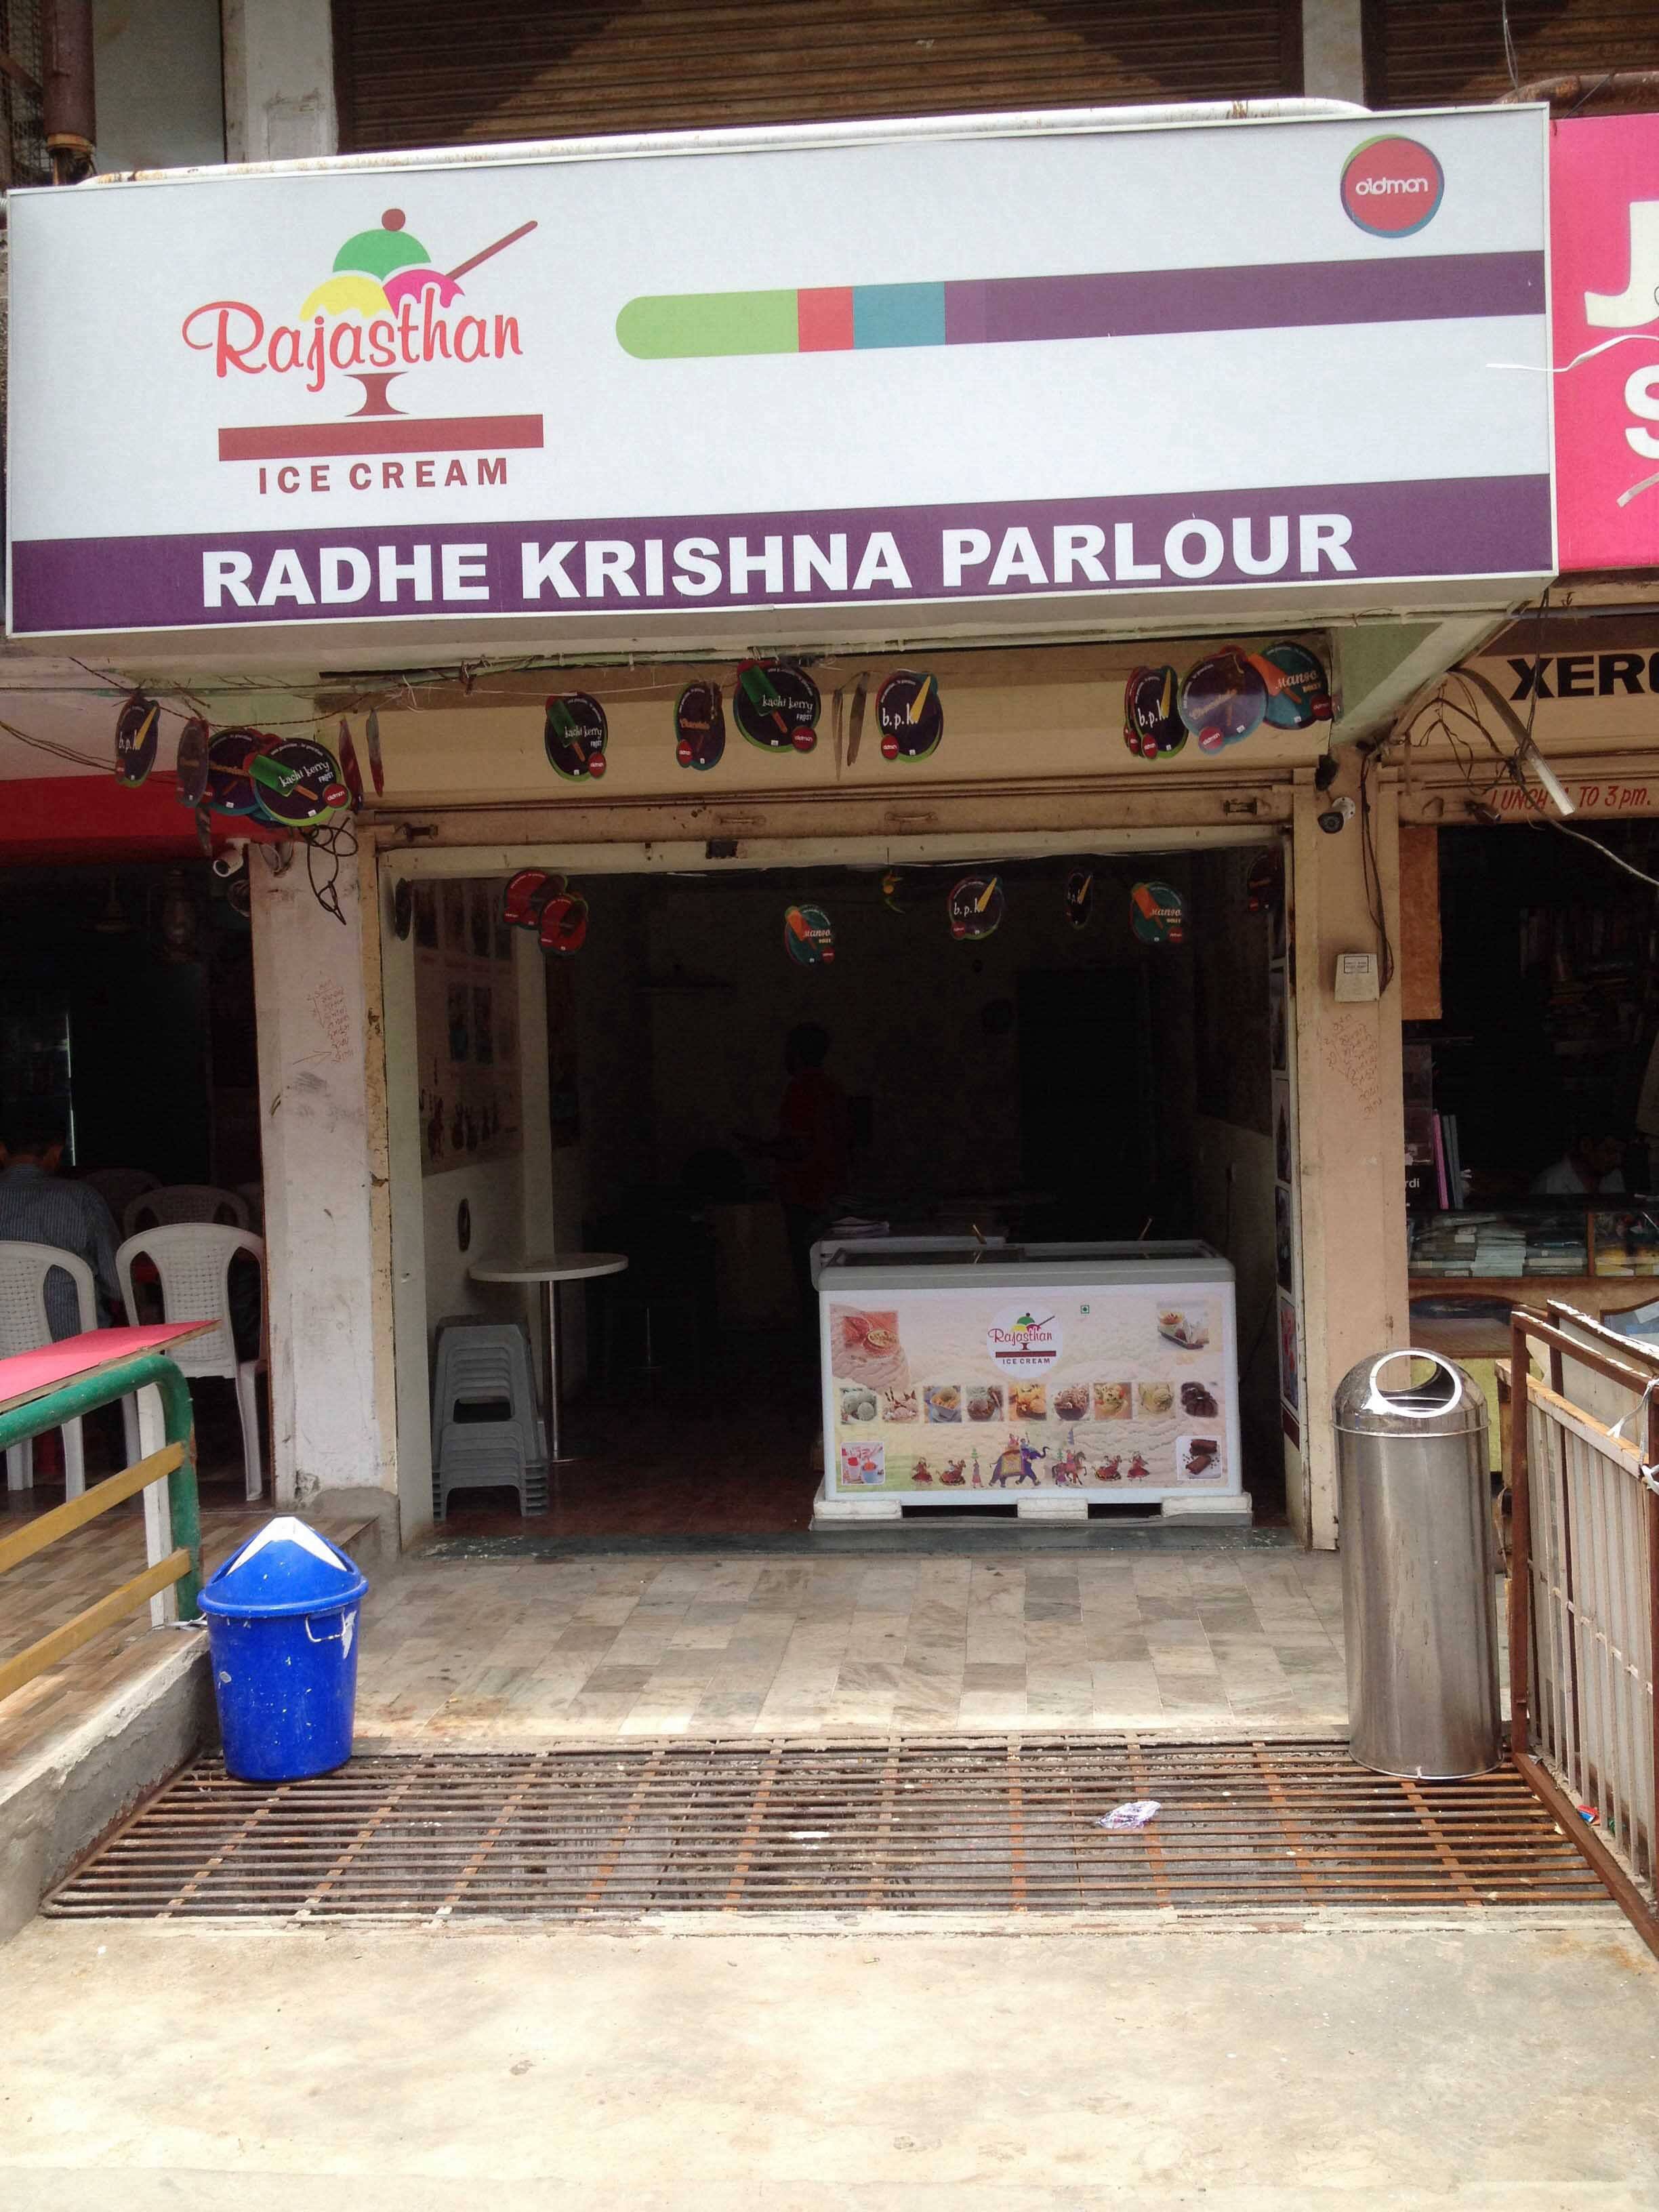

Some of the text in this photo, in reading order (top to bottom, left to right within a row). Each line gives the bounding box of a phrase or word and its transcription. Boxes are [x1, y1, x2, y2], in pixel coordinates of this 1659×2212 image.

[1355, 177, 1429, 196] oldman
[182, 281, 524, 392] Rajasthan
[258, 457, 508, 495] ICE CREAM
[203, 514, 1358, 608] RADHE KRISHNA PARLOUR
[1507, 652, 1659, 701] XER
[1579, 785, 1600, 808] TO
[1604, 785, 1620, 806] 3
[988, 1326, 1052, 1346] Rajasthan
